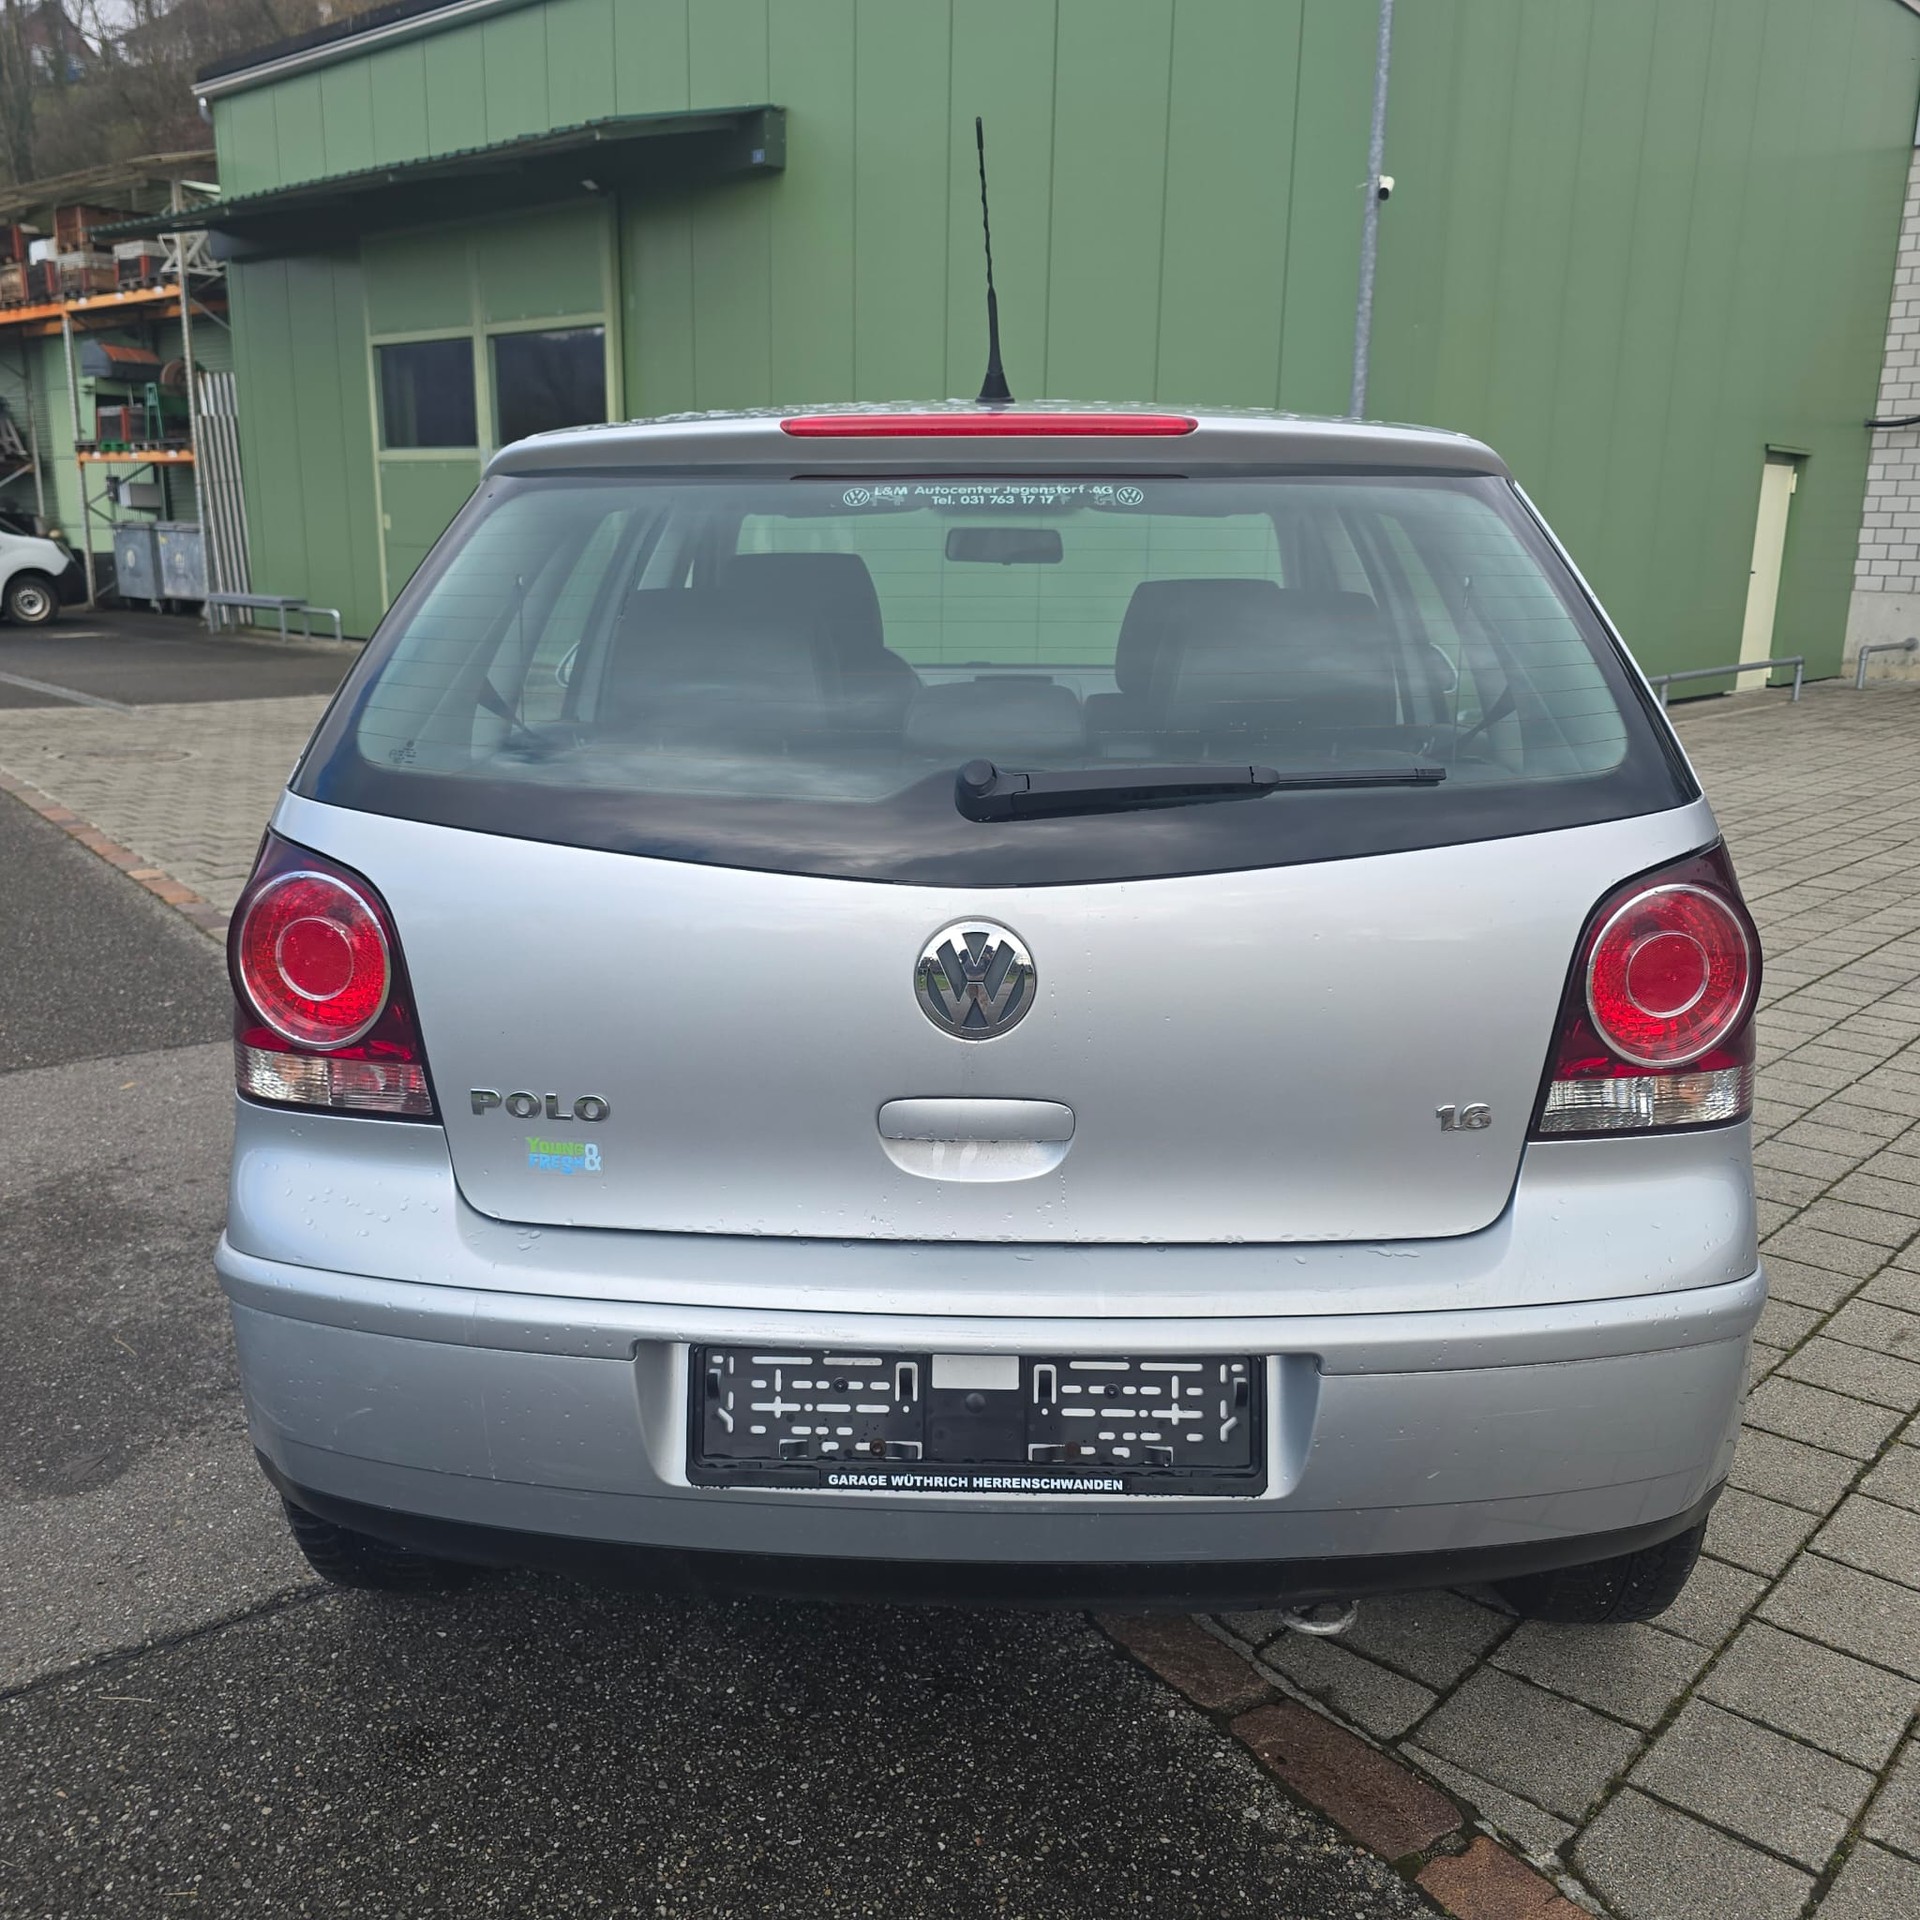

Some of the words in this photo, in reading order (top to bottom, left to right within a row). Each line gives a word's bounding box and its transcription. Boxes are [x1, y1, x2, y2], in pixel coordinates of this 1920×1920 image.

[874, 486, 908, 496] L&M
[914, 485, 999, 495] Autocenter
[1003, 484, 1084, 496] Jegenstorf
[932, 495, 956, 505] Tel.
[960, 495, 985, 505] 031
[990, 495, 1015, 505] 763
[1022, 495, 1036, 505] 17
[1040, 495, 1054, 505] 17
[470, 1087, 611, 1124] POLO
[828, 1474, 887, 1486] GARAGE
[891, 1474, 968, 1488] WÜTHRICH
[972, 1476, 1124, 1491] HERRENSCHWANDEN
